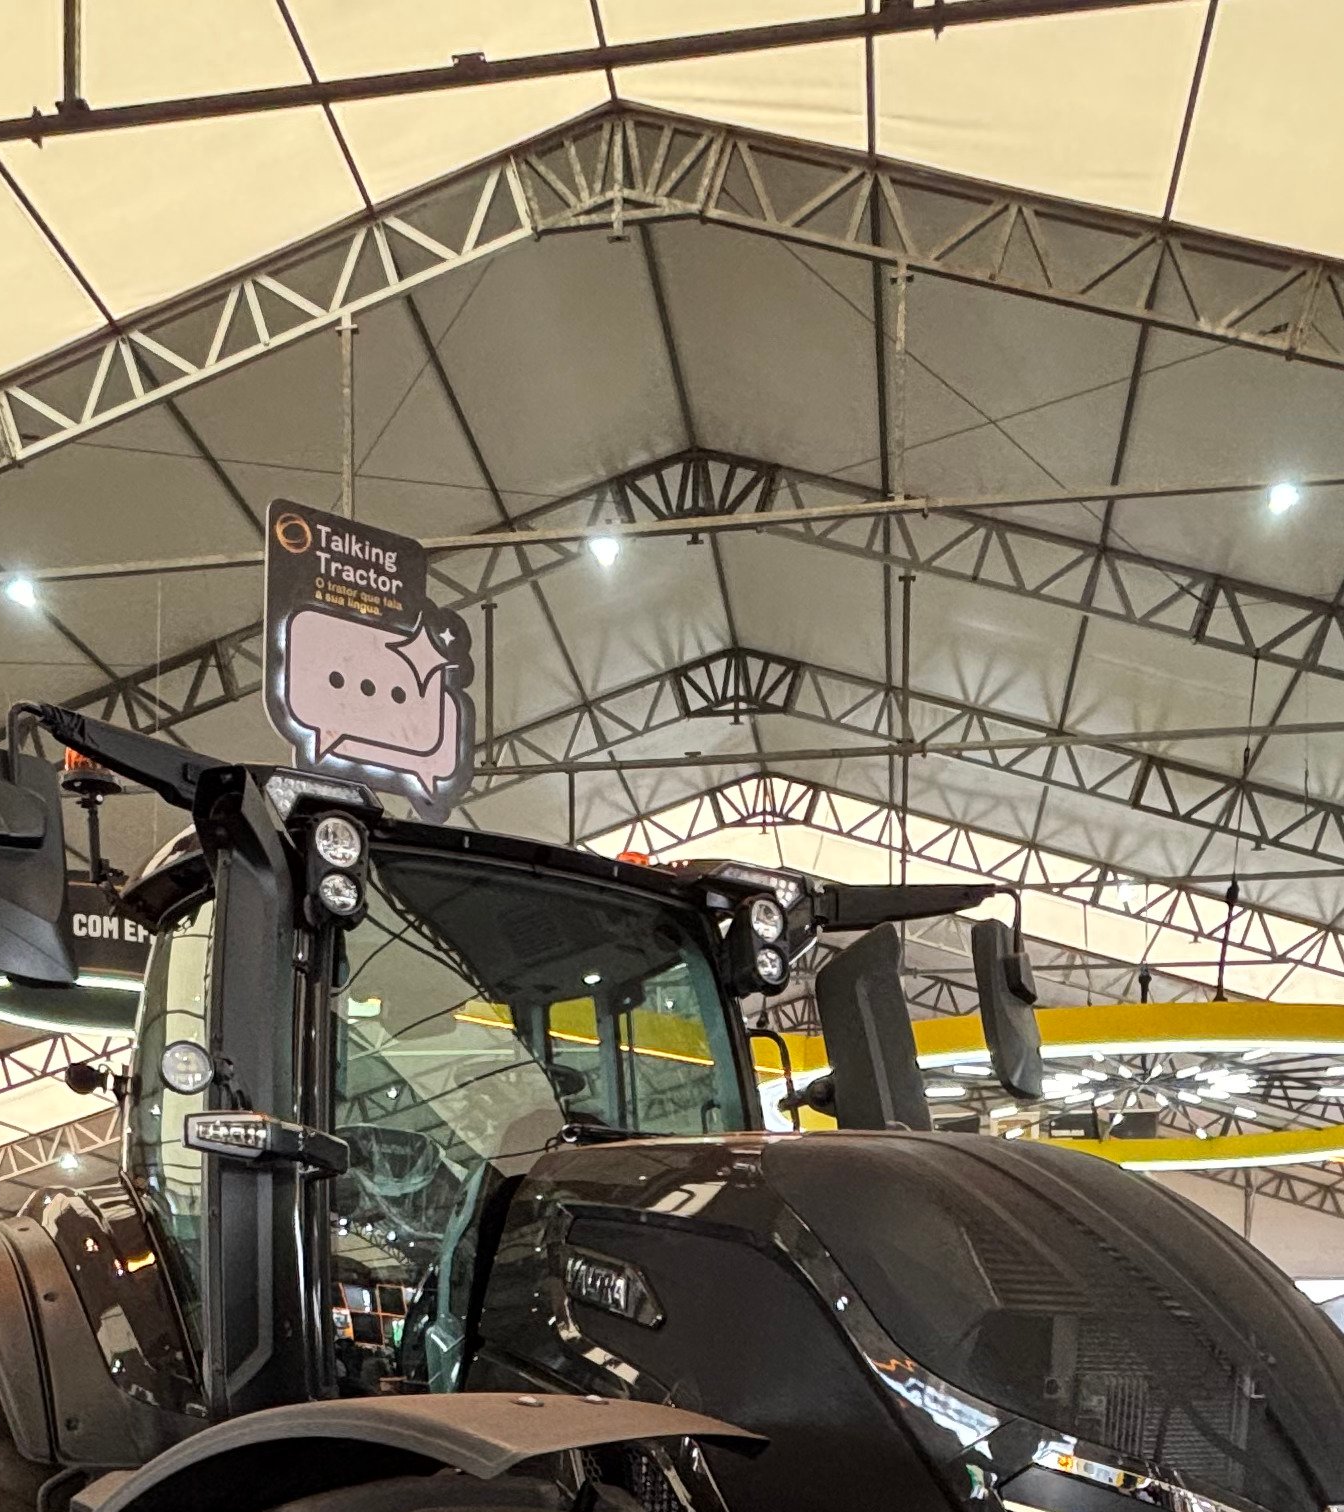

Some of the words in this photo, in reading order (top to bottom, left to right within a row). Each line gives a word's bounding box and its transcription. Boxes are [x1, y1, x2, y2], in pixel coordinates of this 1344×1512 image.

[316, 524, 398, 573] Talking
[315, 550, 404, 595] Tractor
[360, 591, 381, 604] que
[72, 913, 120, 940] COM
